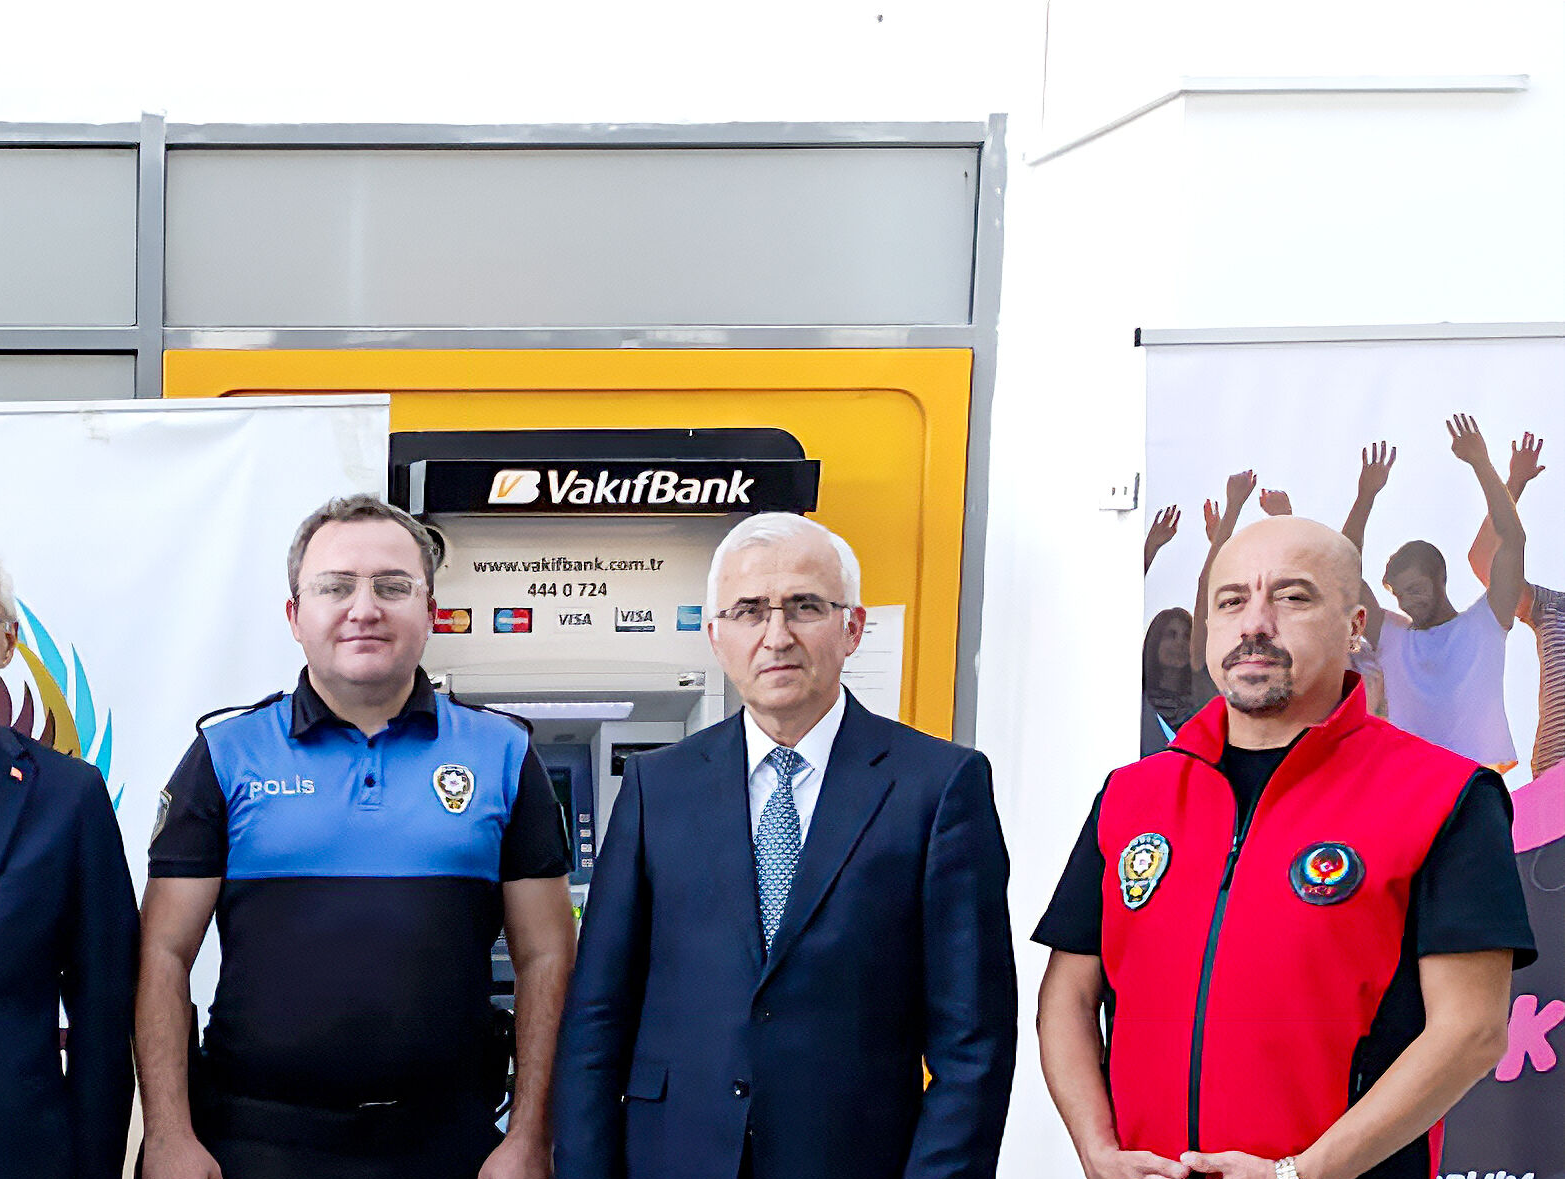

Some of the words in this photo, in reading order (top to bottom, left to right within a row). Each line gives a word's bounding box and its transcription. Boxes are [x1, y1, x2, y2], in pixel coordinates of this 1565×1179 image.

[473, 557, 663, 573] www.vakifbank.com.tr
[528, 584, 558, 598] 444
[563, 584, 572, 597] 0
[578, 583, 607, 597] 724
[559, 613, 591, 626] VISA
[621, 610, 653, 623] VISA
[250, 775, 315, 798] POLİS
